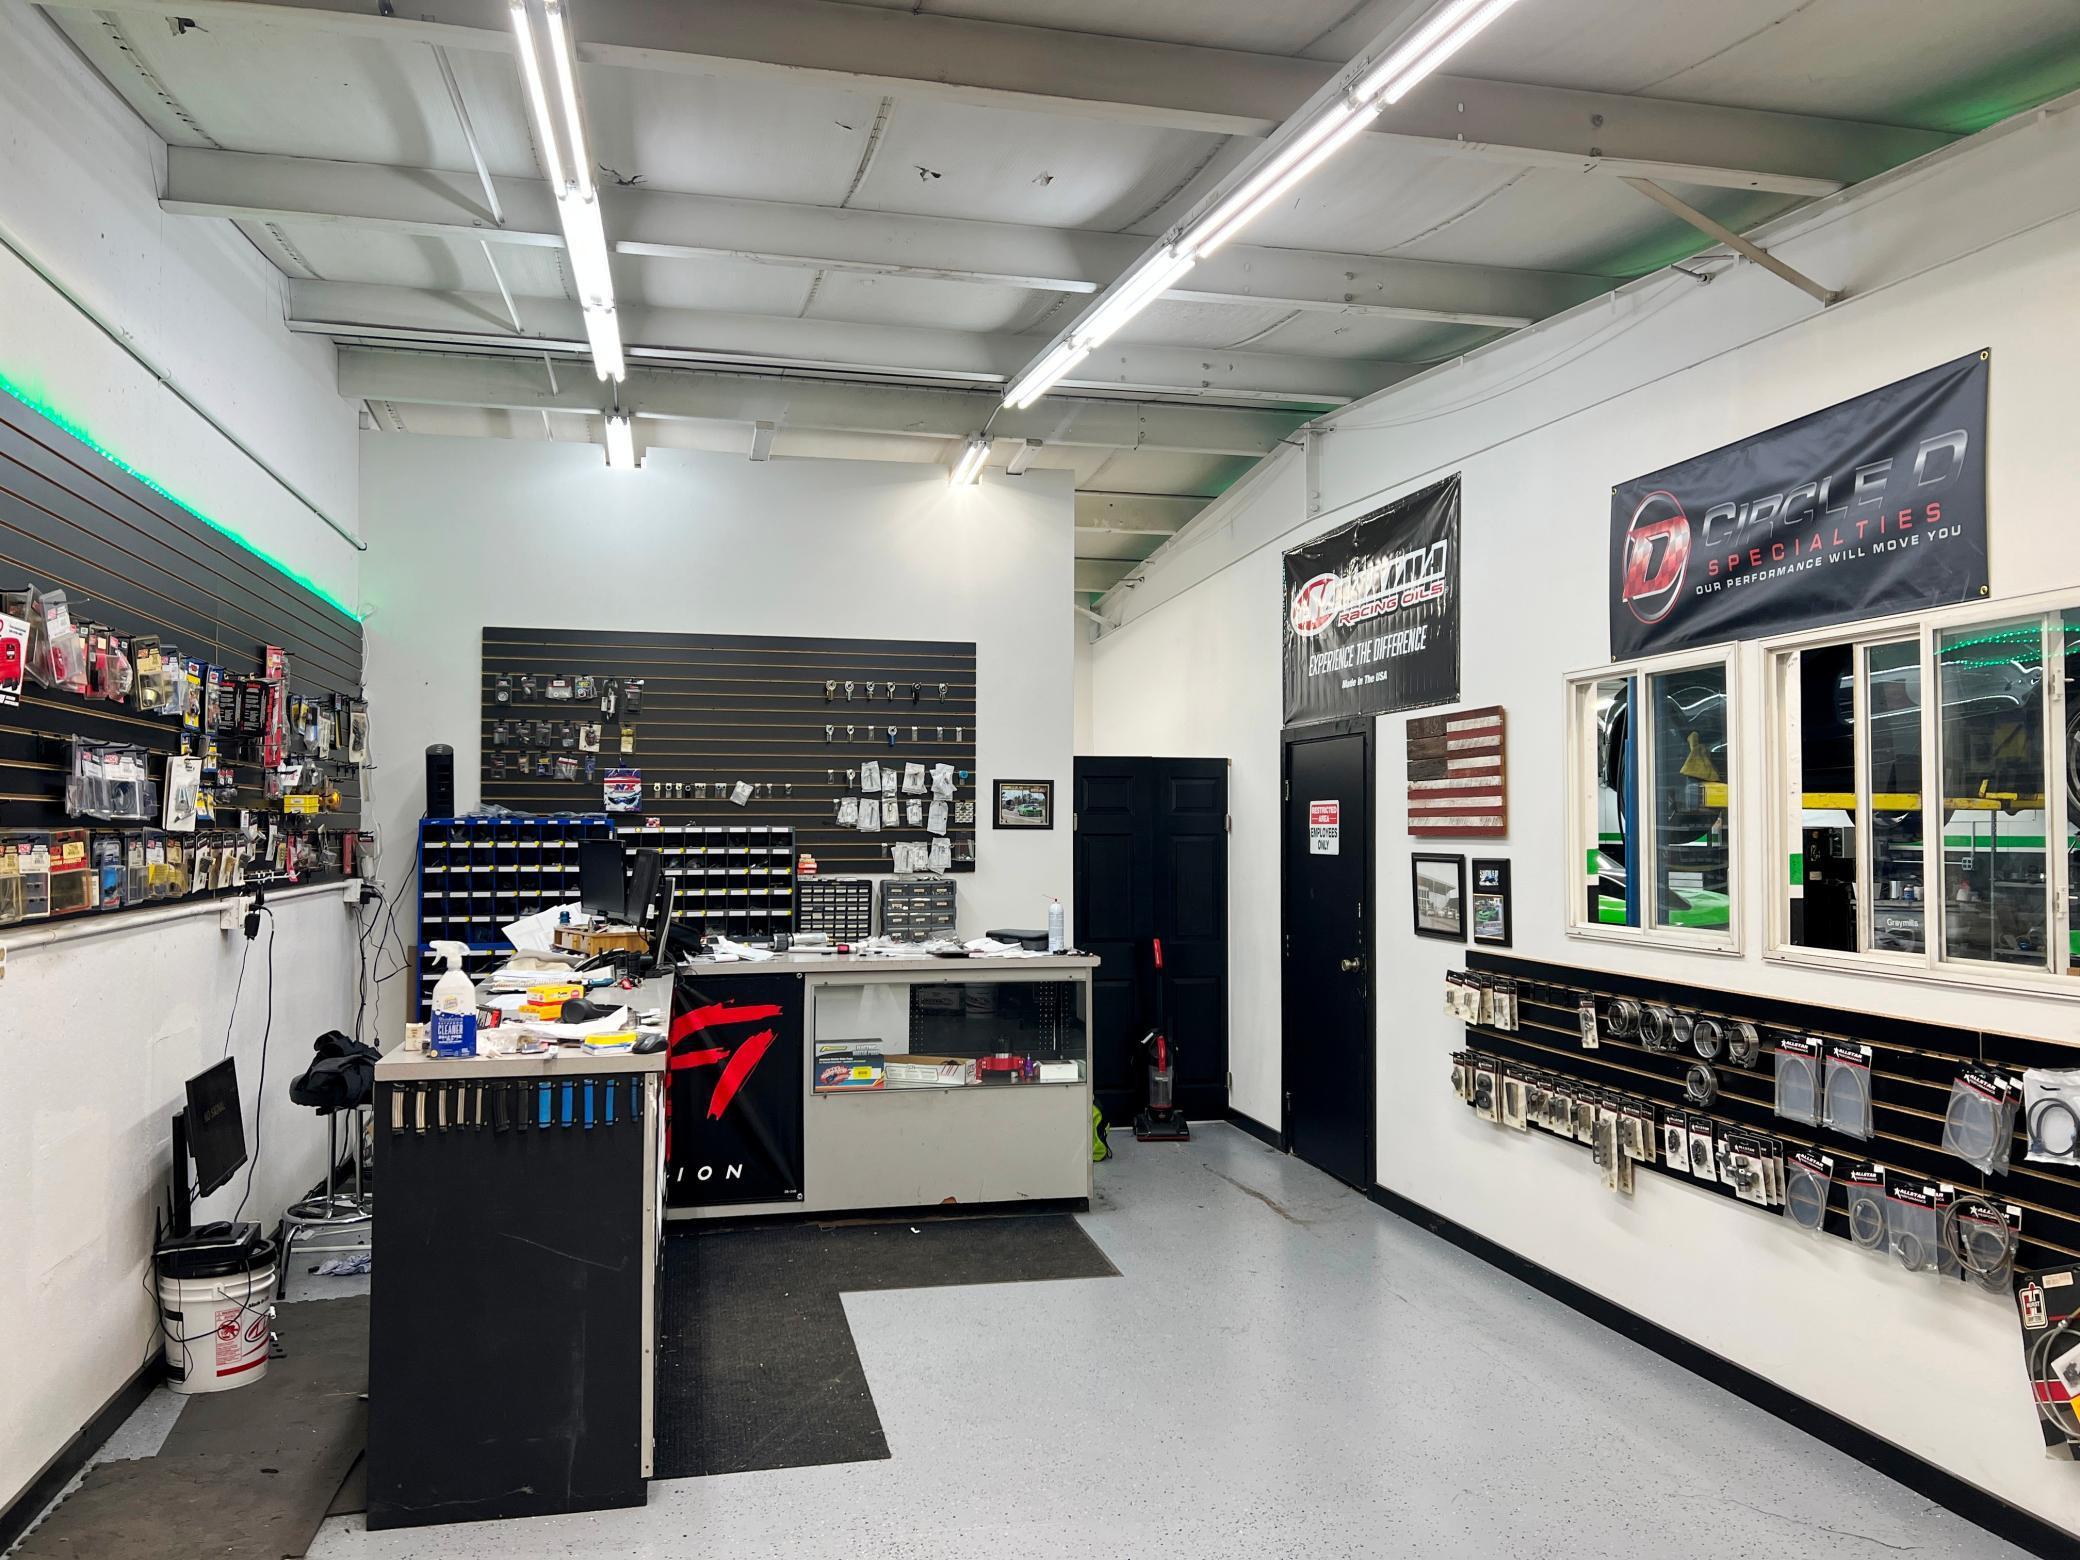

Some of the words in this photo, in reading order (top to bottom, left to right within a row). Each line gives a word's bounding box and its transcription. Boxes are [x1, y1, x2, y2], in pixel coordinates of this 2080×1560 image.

[1701, 457, 1893, 547] CIRCLE
[1912, 429, 1968, 487] D
[1708, 502, 1942, 576] SPECIALTIES
[1696, 581, 1722, 595] OUR
[1726, 556, 1823, 588] PERFORMANCE
[1829, 548, 1866, 563] WILL
[1873, 535, 1920, 553] MOVE
[1927, 524, 1962, 542] YOU
[1402, 582, 1443, 604] OILS
[1309, 645, 1355, 676] EXPERIENCE
[1356, 640, 1373, 665] THE
[1373, 625, 1428, 661] DIFFERENCE
[1342, 678, 1356, 688] Made
[1364, 674, 1375, 684] The
[1375, 671, 1388, 681] USA
[1311, 806, 1337, 814] RESTRICTED
[1311, 827, 1338, 838] EMPLOYEES
[1317, 839, 1330, 851] ONLY
[437, 1024, 464, 1035] CLEANER
[1786, 1041, 1809, 1050] ALLSTAR
[1839, 1048, 1863, 1059] ALLSTAR
[1969, 1074, 1997, 1090] ALLSTAR
[1801, 1154, 1824, 1168] ALLSTAR
[666, 1163, 743, 1183] ION
[1900, 1189, 1927, 1200] ALLSTAR
